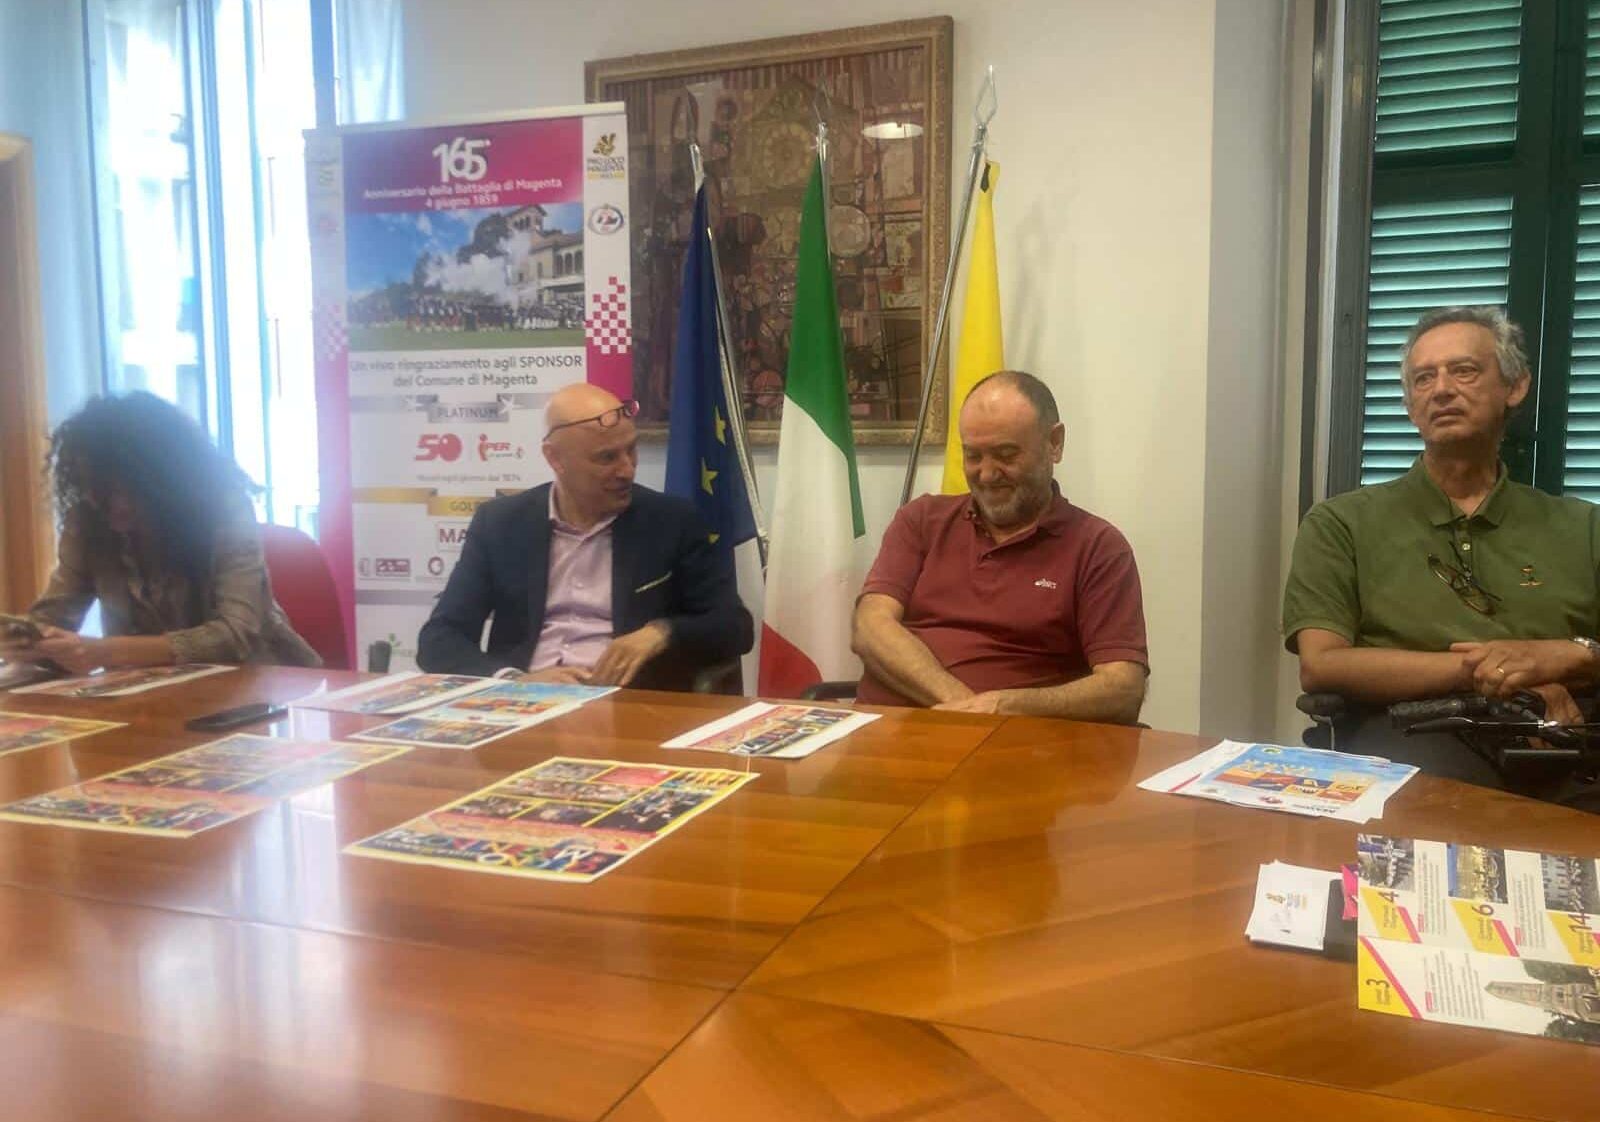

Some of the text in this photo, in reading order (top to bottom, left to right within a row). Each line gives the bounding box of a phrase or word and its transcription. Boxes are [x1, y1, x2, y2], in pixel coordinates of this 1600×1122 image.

[455, 181, 501, 194] Battaglia
[503, 179, 514, 191] di
[515, 178, 562, 193] Magenta
[398, 357, 490, 373] ringraziamento
[494, 356, 516, 372] agli
[519, 355, 583, 369] SPONSOR
[393, 373, 538, 389] del Comune di Magenta
[438, 407, 498, 419] PLATINUM
[448, 501, 474, 512] GOL
[1377, 891, 1399, 903] 4
[1471, 904, 1494, 916] 6
[1568, 911, 1593, 932] 14
[1366, 978, 1390, 988] 3
